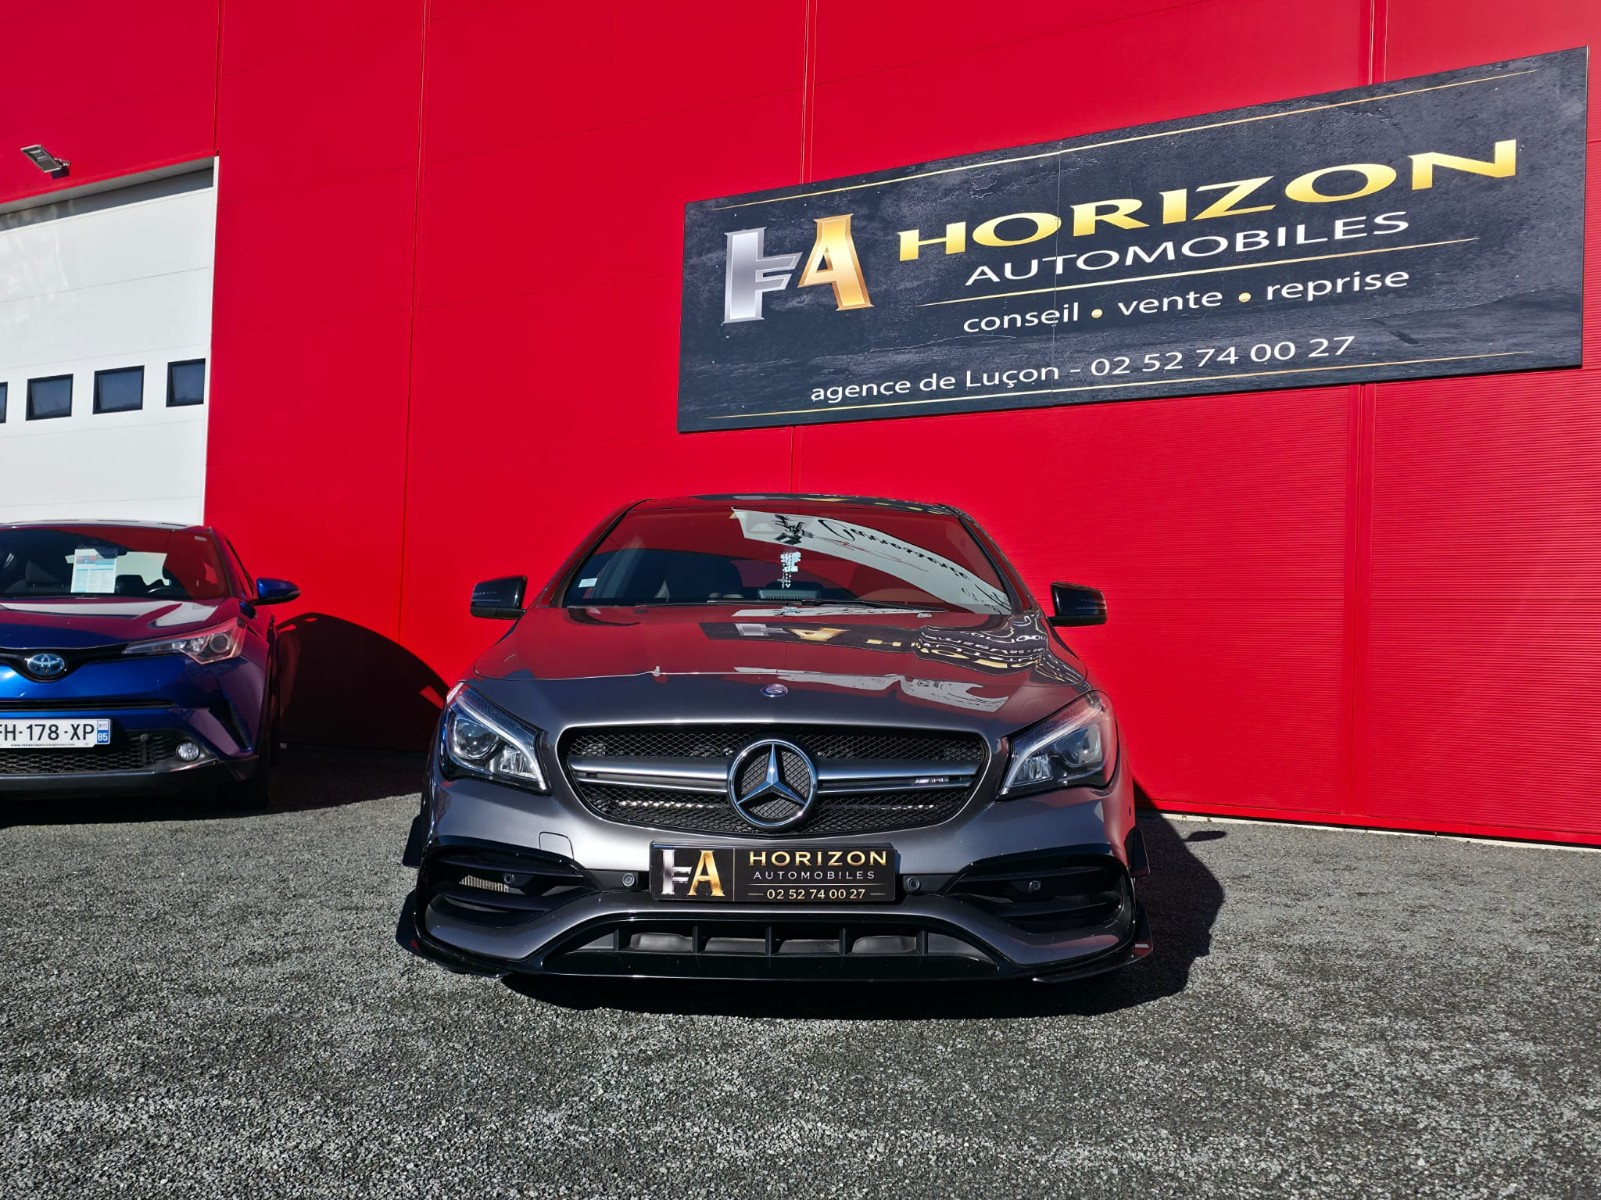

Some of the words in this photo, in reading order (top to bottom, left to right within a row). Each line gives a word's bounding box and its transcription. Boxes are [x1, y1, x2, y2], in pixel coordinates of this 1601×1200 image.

[897, 139, 1518, 262] HORIZON
[964, 211, 1410, 287] AUTOMOBILES
[963, 302, 1079, 333] conseil
[1117, 291, 1224, 316] vente
[1266, 271, 1410, 302] reprise
[810, 380, 912, 404] agence
[919, 372, 956, 392] de
[966, 365, 1060, 389] Luçon
[1090, 356, 1131, 377] 02
[1142, 351, 1183, 373] 52
[1196, 346, 1239, 368] 74
[1250, 341, 1296, 363] 00
[1308, 335, 1356, 359] 27
[0, 723, 95, 742] H-178-XP
[97, 732, 109, 742] 85
[748, 851, 887, 867] HORIZON
[753, 871, 876, 880] AUTOMOBILES
[766, 889, 785, 900] 02
[788, 889, 806, 900] 52
[810, 889, 826, 900] 74
[829, 889, 846, 900] 00
[849, 889, 866, 900] 27
